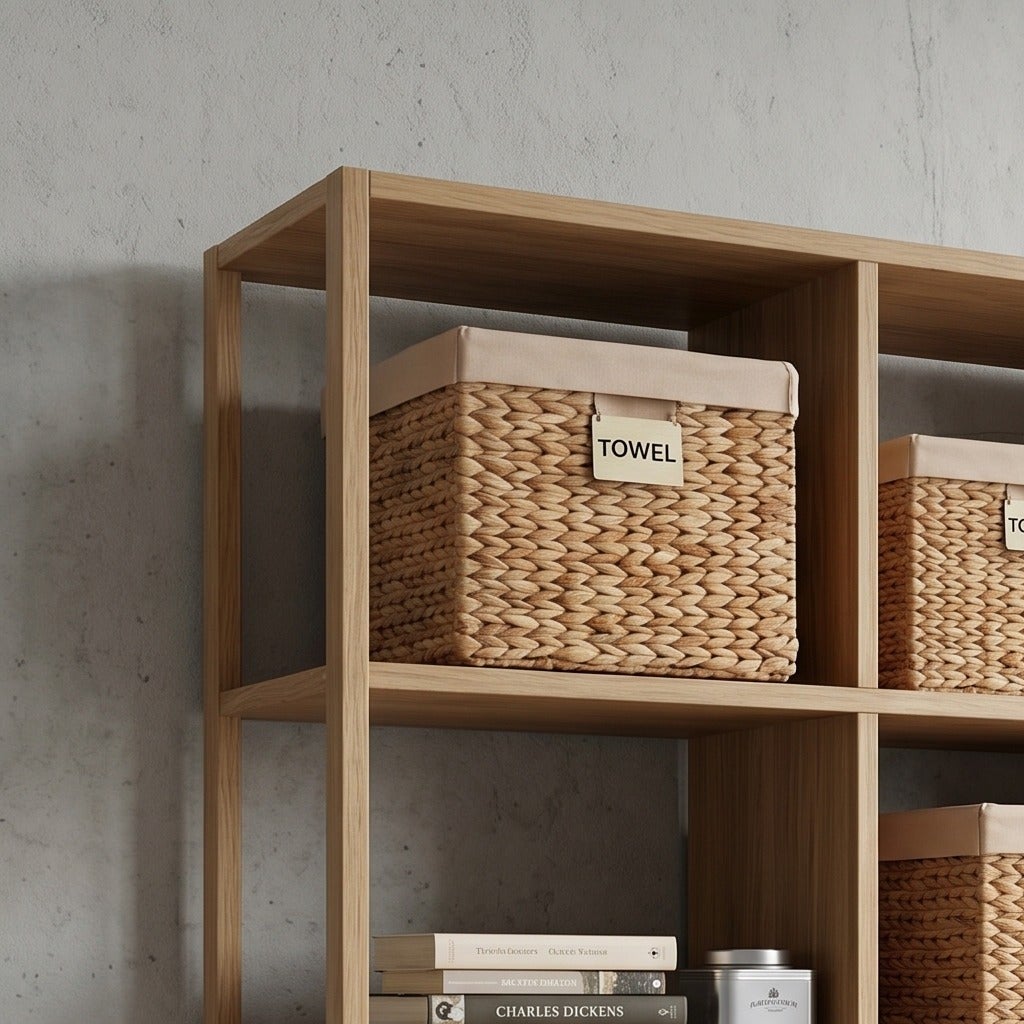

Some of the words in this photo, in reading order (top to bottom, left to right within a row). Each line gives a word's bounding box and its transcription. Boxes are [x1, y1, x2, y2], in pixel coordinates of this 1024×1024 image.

[597, 439, 677, 463] TOWEL
[496, 1005, 559, 1018] CHARLES
[563, 1005, 624, 1018] DICKENS
